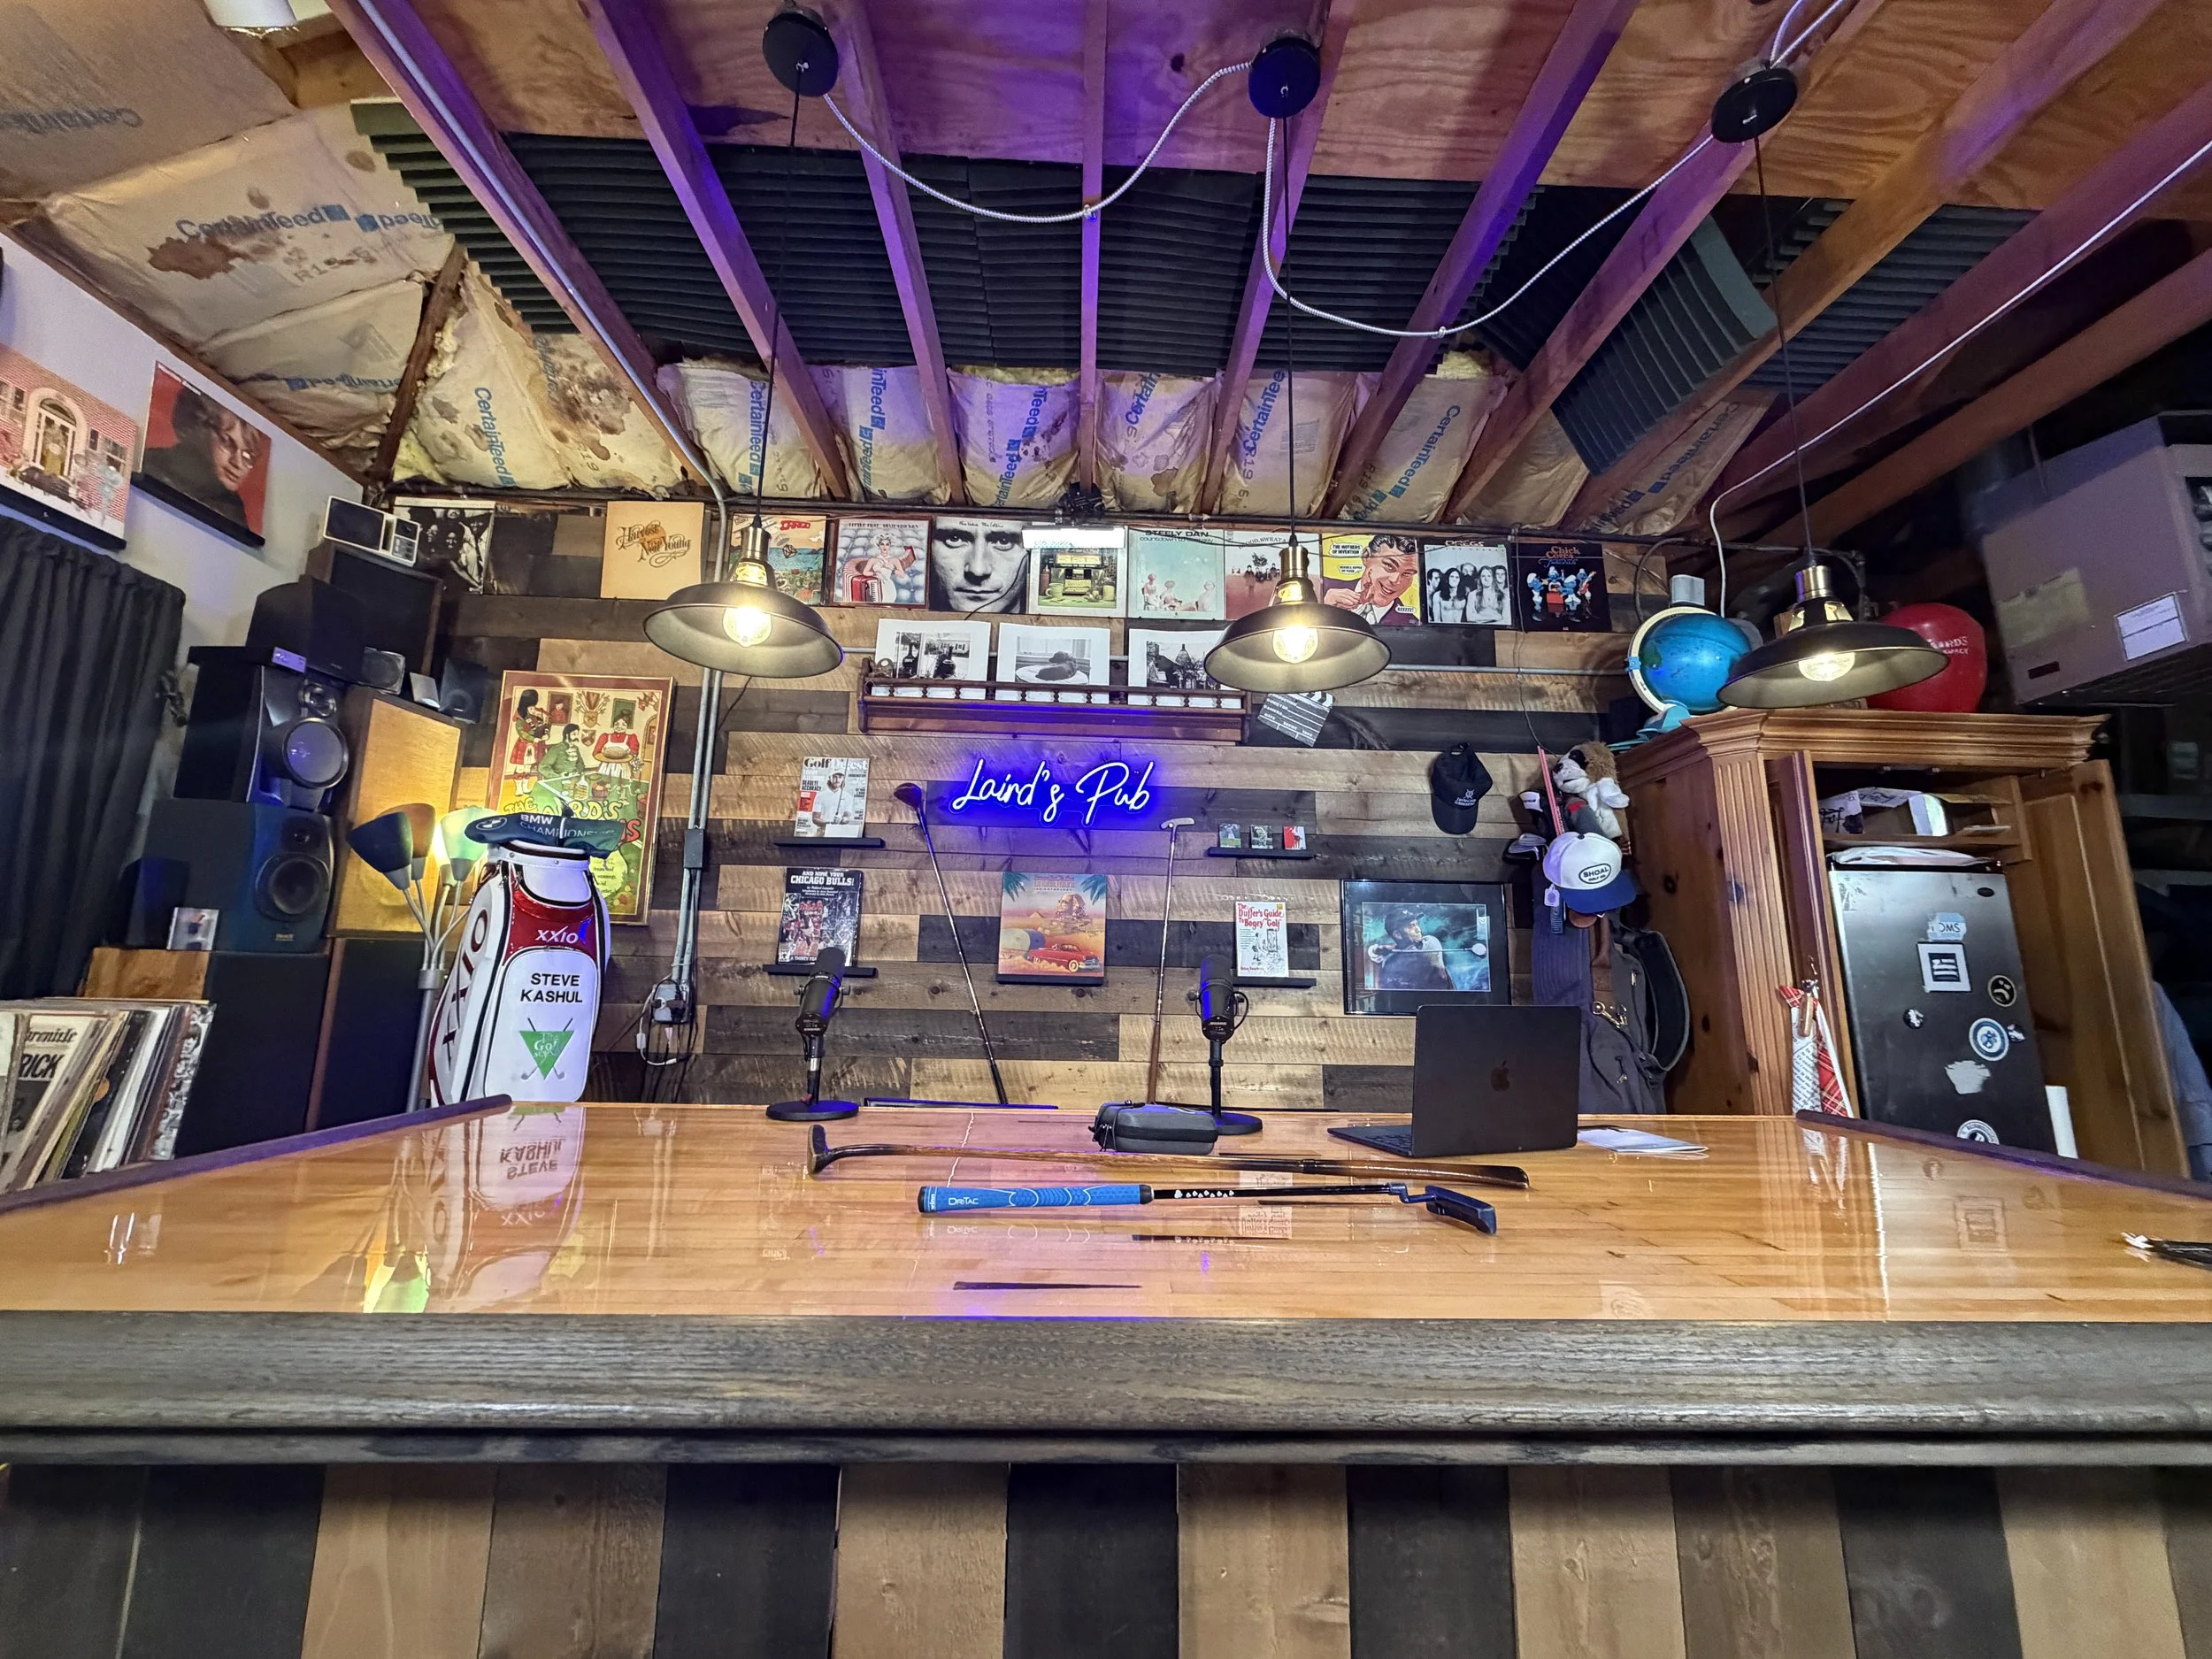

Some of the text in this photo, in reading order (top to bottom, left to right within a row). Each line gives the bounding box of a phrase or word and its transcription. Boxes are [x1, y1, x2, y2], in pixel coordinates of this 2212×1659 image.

[474, 387, 510, 475] CertainTeed
[1397, 404, 1460, 492] CertainTeed
[1551, 545, 1581, 555] Chick
[803, 757, 832, 768] Golf
[952, 758, 1154, 824] Laird's Pub
[520, 814, 553, 826] BMW
[1583, 866, 1609, 878] SHOAL
[790, 875, 855, 886] CHICAGO BULLS!
[1238, 906, 1285, 919] Duffer's Guide
[1244, 918, 1264, 930] Bogey
[1266, 918, 1282, 932] Golf
[534, 926, 579, 944] XXIO
[531, 973, 580, 987] STEVE
[520, 989, 583, 1003] KASHUL
